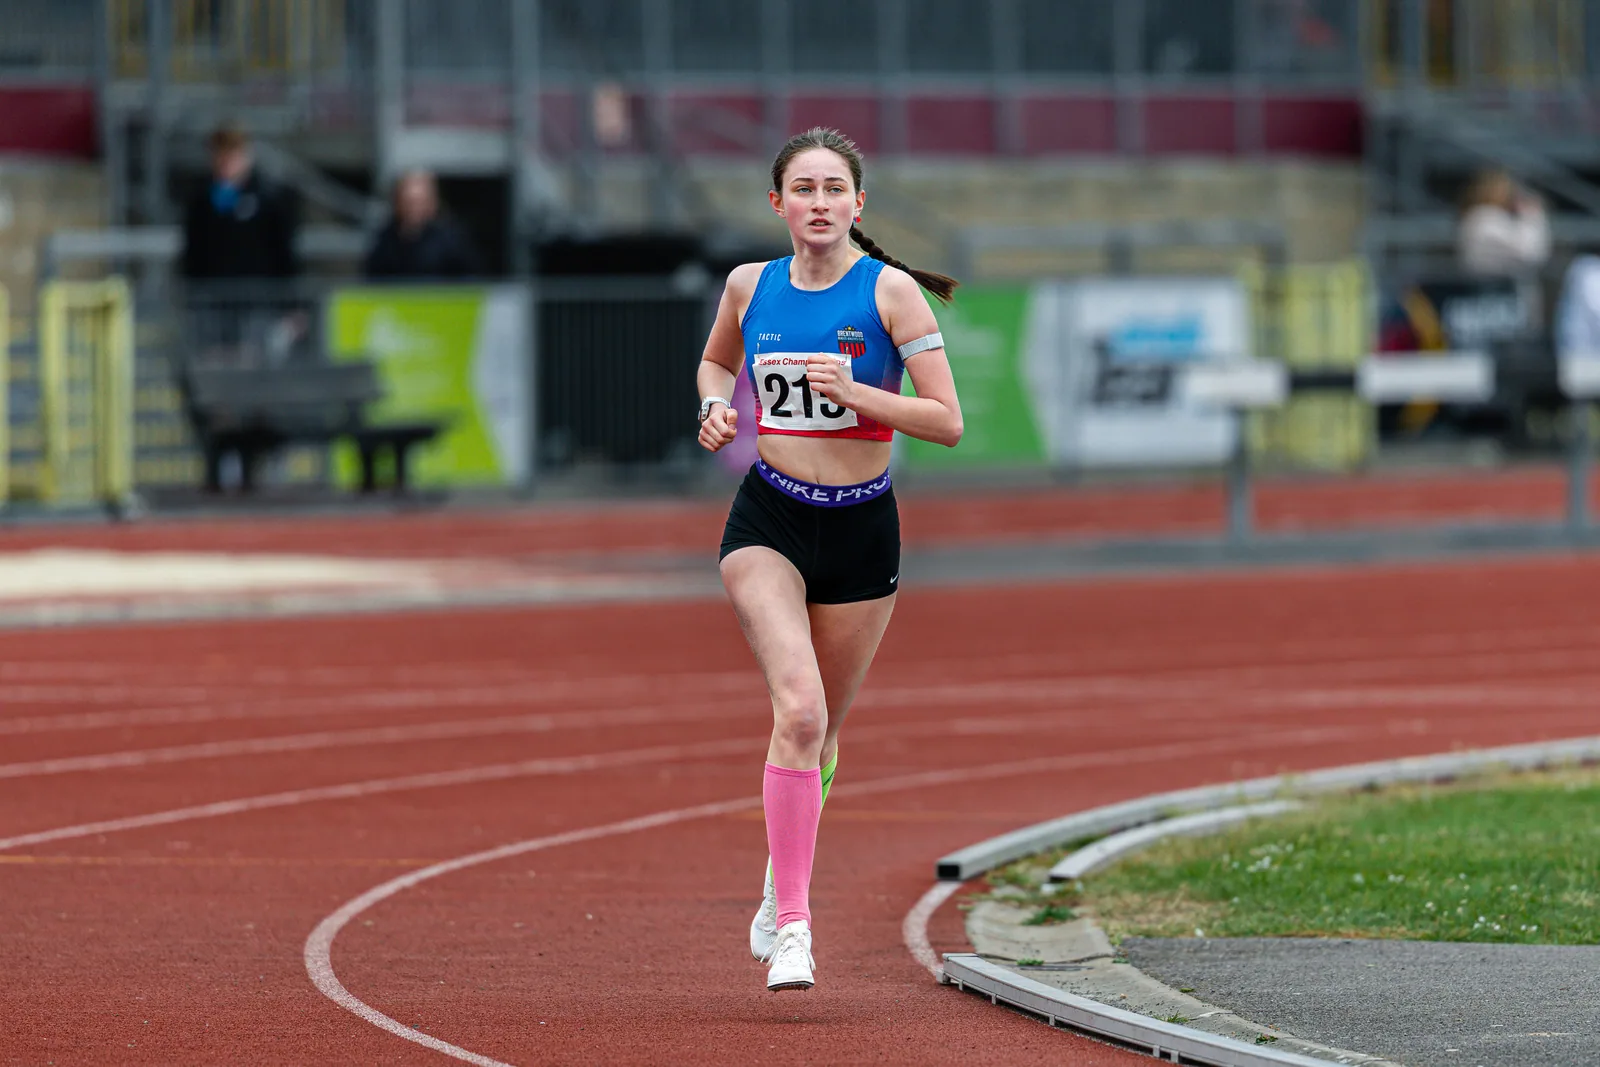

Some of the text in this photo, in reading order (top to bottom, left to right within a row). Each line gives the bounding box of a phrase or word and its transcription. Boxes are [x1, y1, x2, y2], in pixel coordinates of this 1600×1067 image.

[758, 333, 781, 342] TACTIC
[759, 358, 781, 366] Essex
[770, 472, 830, 502] NIKE
